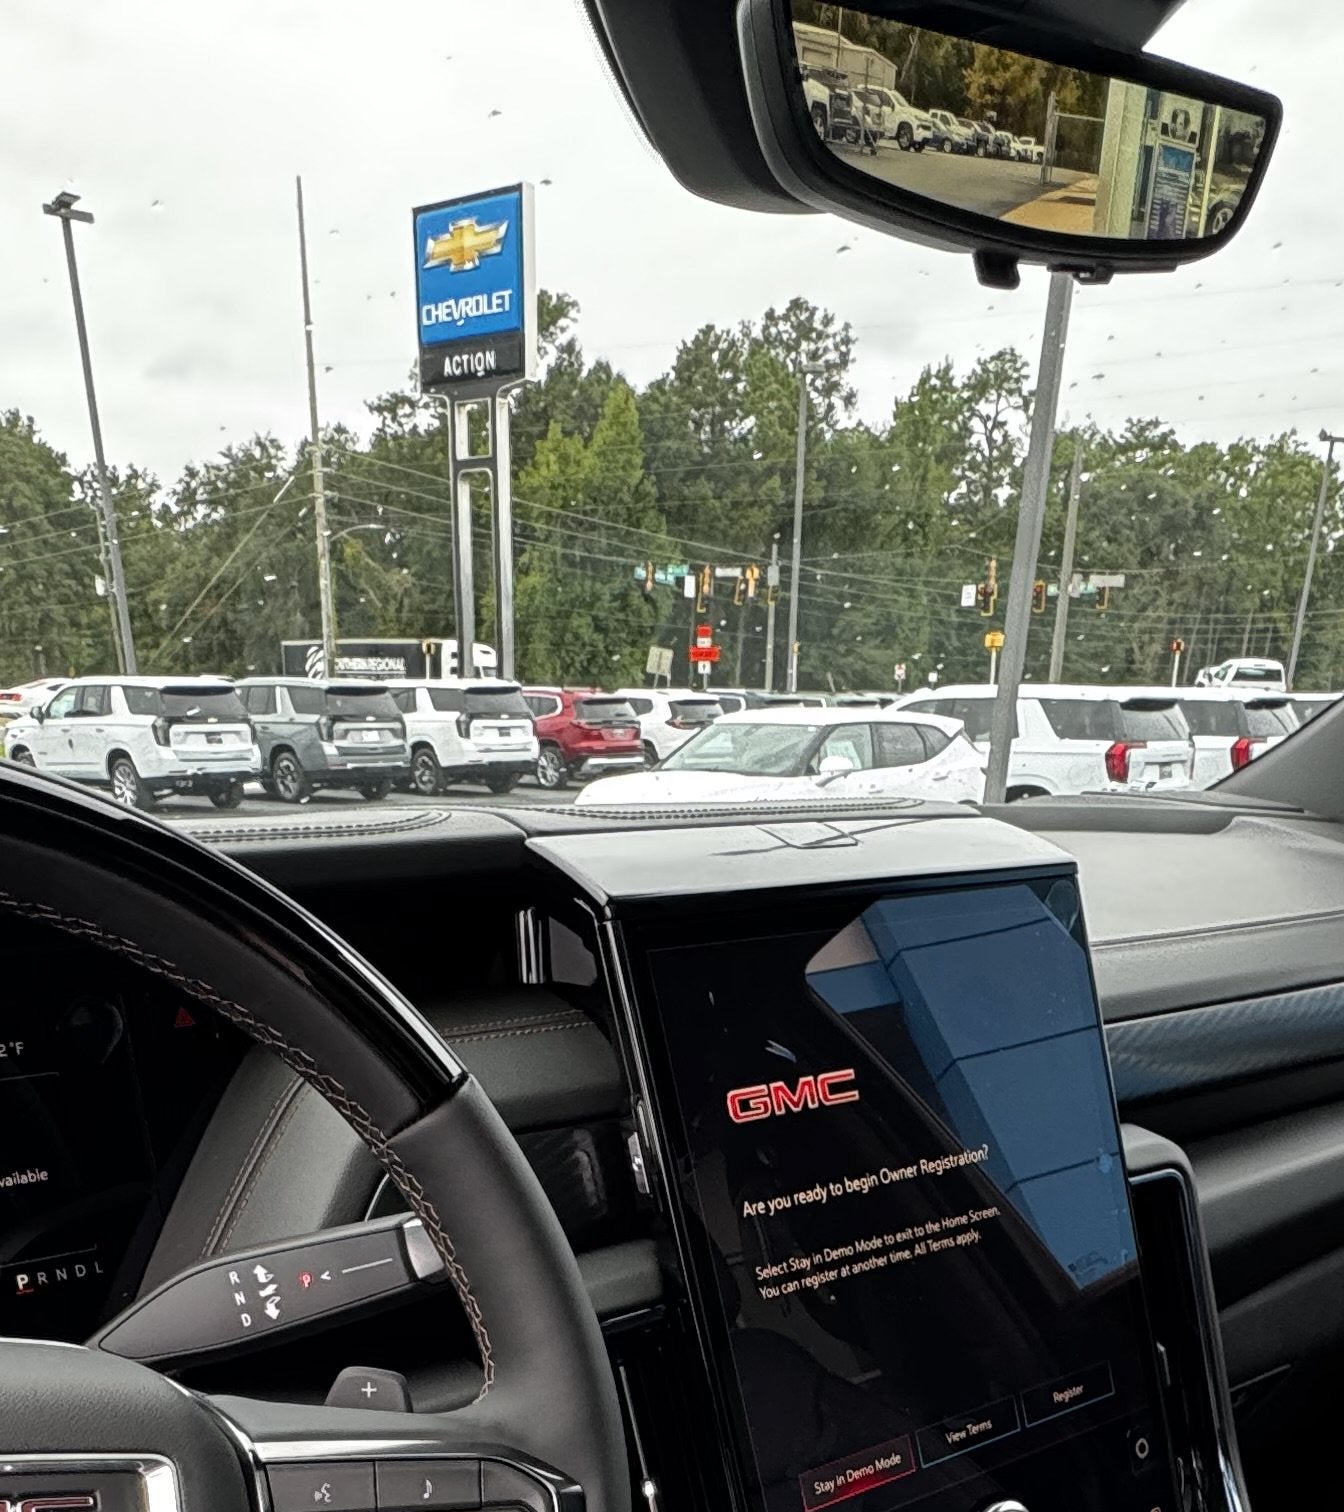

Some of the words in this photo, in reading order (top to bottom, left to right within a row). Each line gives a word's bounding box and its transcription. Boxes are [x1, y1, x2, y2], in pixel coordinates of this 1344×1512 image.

[422, 289, 512, 325] CHEVROLET
[444, 350, 497, 376] ACTION
[726, 1068, 859, 1124] GMC
[743, 1200, 765, 1218] Are
[768, 1195, 791, 1216] you
[794, 1185, 828, 1205] ready
[830, 1182, 843, 1197] to
[844, 1174, 878, 1194] begin
[880, 1164, 918, 1184] Owner
[920, 1144, 989, 1176] Registration?
[756, 1262, 788, 1280] Select
[790, 1256, 812, 1275] Stay
[812, 1252, 822, 1265] in
[823, 1244, 854, 1262] Demo
[855, 1238, 882, 1256] Mode
[884, 1234, 894, 1246] to
[896, 1228, 913, 1243] exit
[914, 1226, 924, 1238] to
[926, 1220, 940, 1234] the
[942, 1214, 968, 1231] Home
[968, 1206, 1000, 1223] Screen.
[16, 1274, 28, 1290] P
[37, 1272, 48, 1285] R
[56, 1268, 67, 1280] N
[75, 1264, 86, 1278] D
[94, 1261, 104, 1273] L
[229, 1272, 240, 1284] R
[759, 1283, 780, 1300] You
[782, 1280, 800, 1294] can
[801, 1268, 838, 1289] register
[840, 1266, 850, 1278] at
[852, 1256, 888, 1274] another
[890, 1250, 912, 1264] time.
[914, 1242, 926, 1256] All
[927, 1236, 955, 1255] Terms
[956, 1229, 982, 1250] apply.
[235, 1292, 246, 1306] N
[241, 1313, 252, 1327] D
[1053, 1384, 1084, 1404] Register
[945, 1429, 966, 1445] View
[967, 1418, 992, 1438] Terms
[814, 1476, 835, 1496] Stay
[836, 1474, 846, 1488] in
[846, 1463, 874, 1482] Demo
[875, 1453, 902, 1473] Mode
